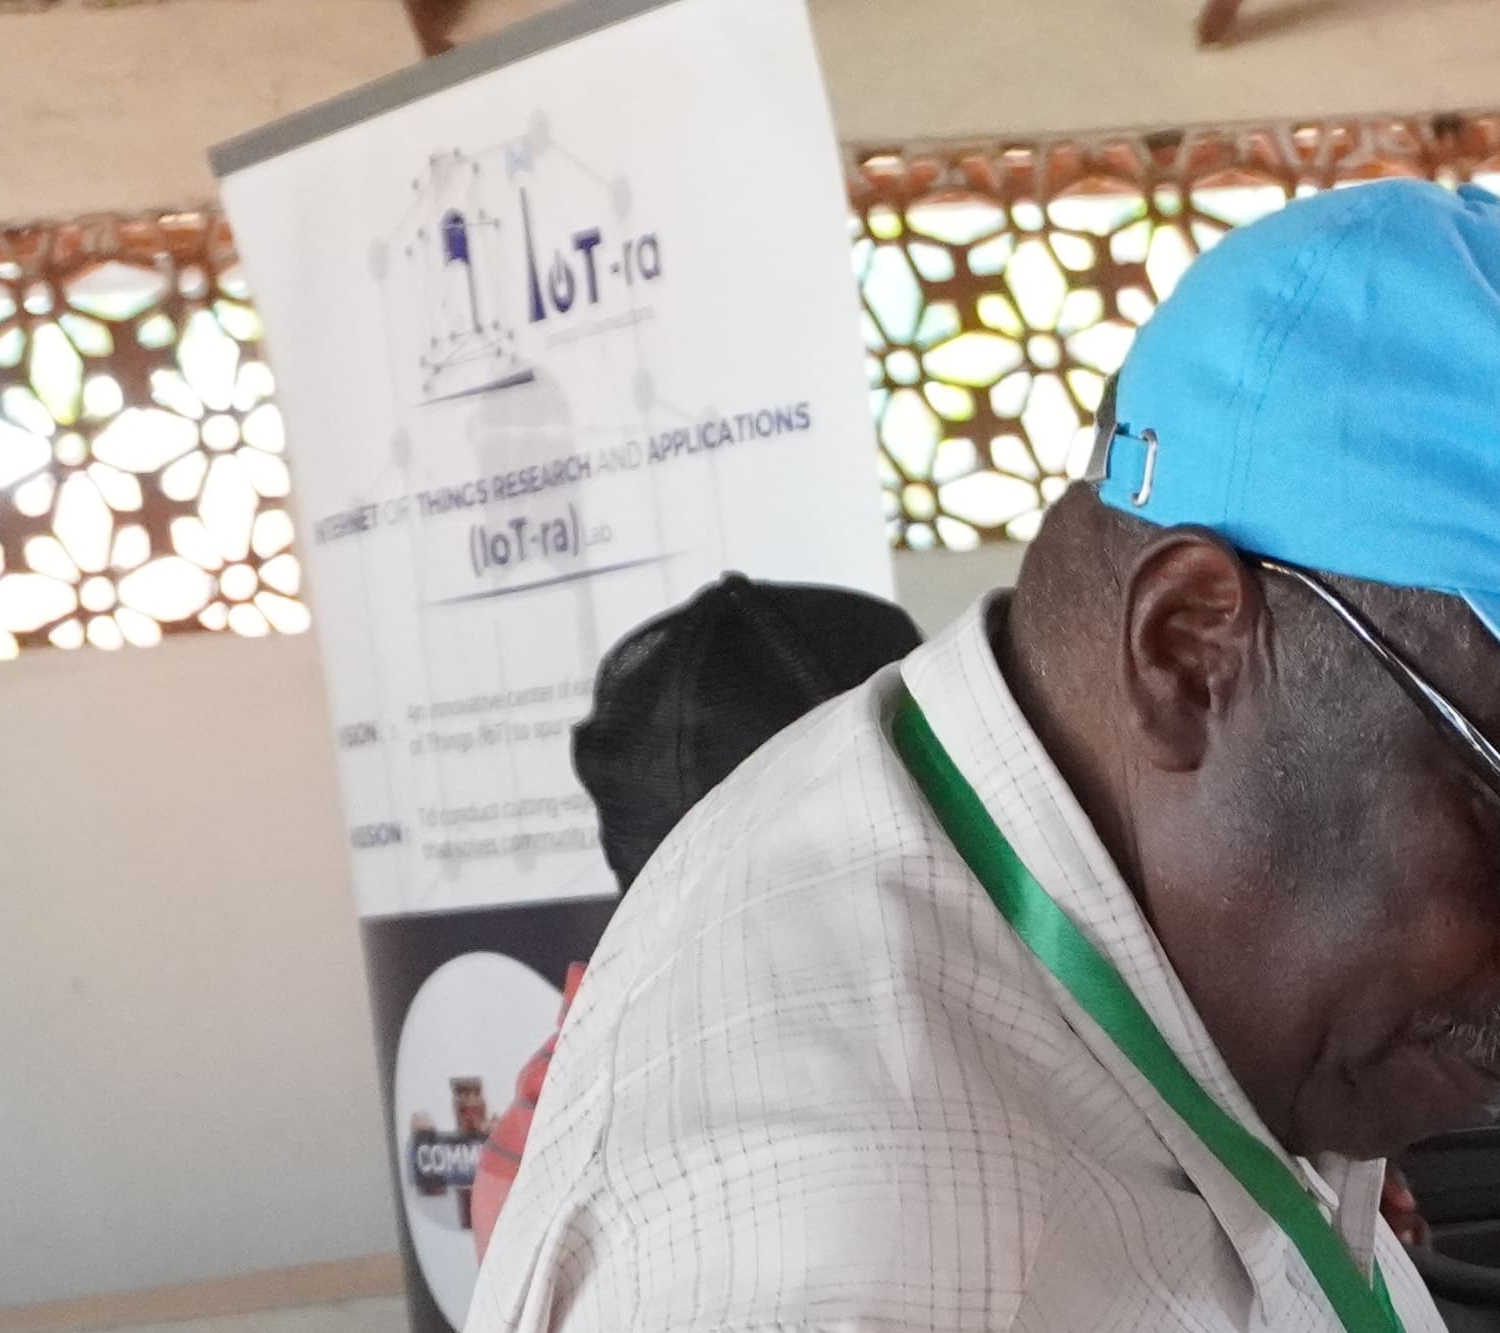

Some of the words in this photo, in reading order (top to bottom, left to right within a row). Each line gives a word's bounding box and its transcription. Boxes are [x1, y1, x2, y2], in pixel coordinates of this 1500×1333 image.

[519, 187, 662, 323] IoT-ra
[416, 480, 489, 519] THINGS
[492, 453, 592, 499] RESEARCH
[597, 441, 643, 474] AND
[648, 401, 812, 465] APPLICATIONS
[469, 502, 580, 577] (IoT-ra)
[417, 1143, 485, 1175] COMM
